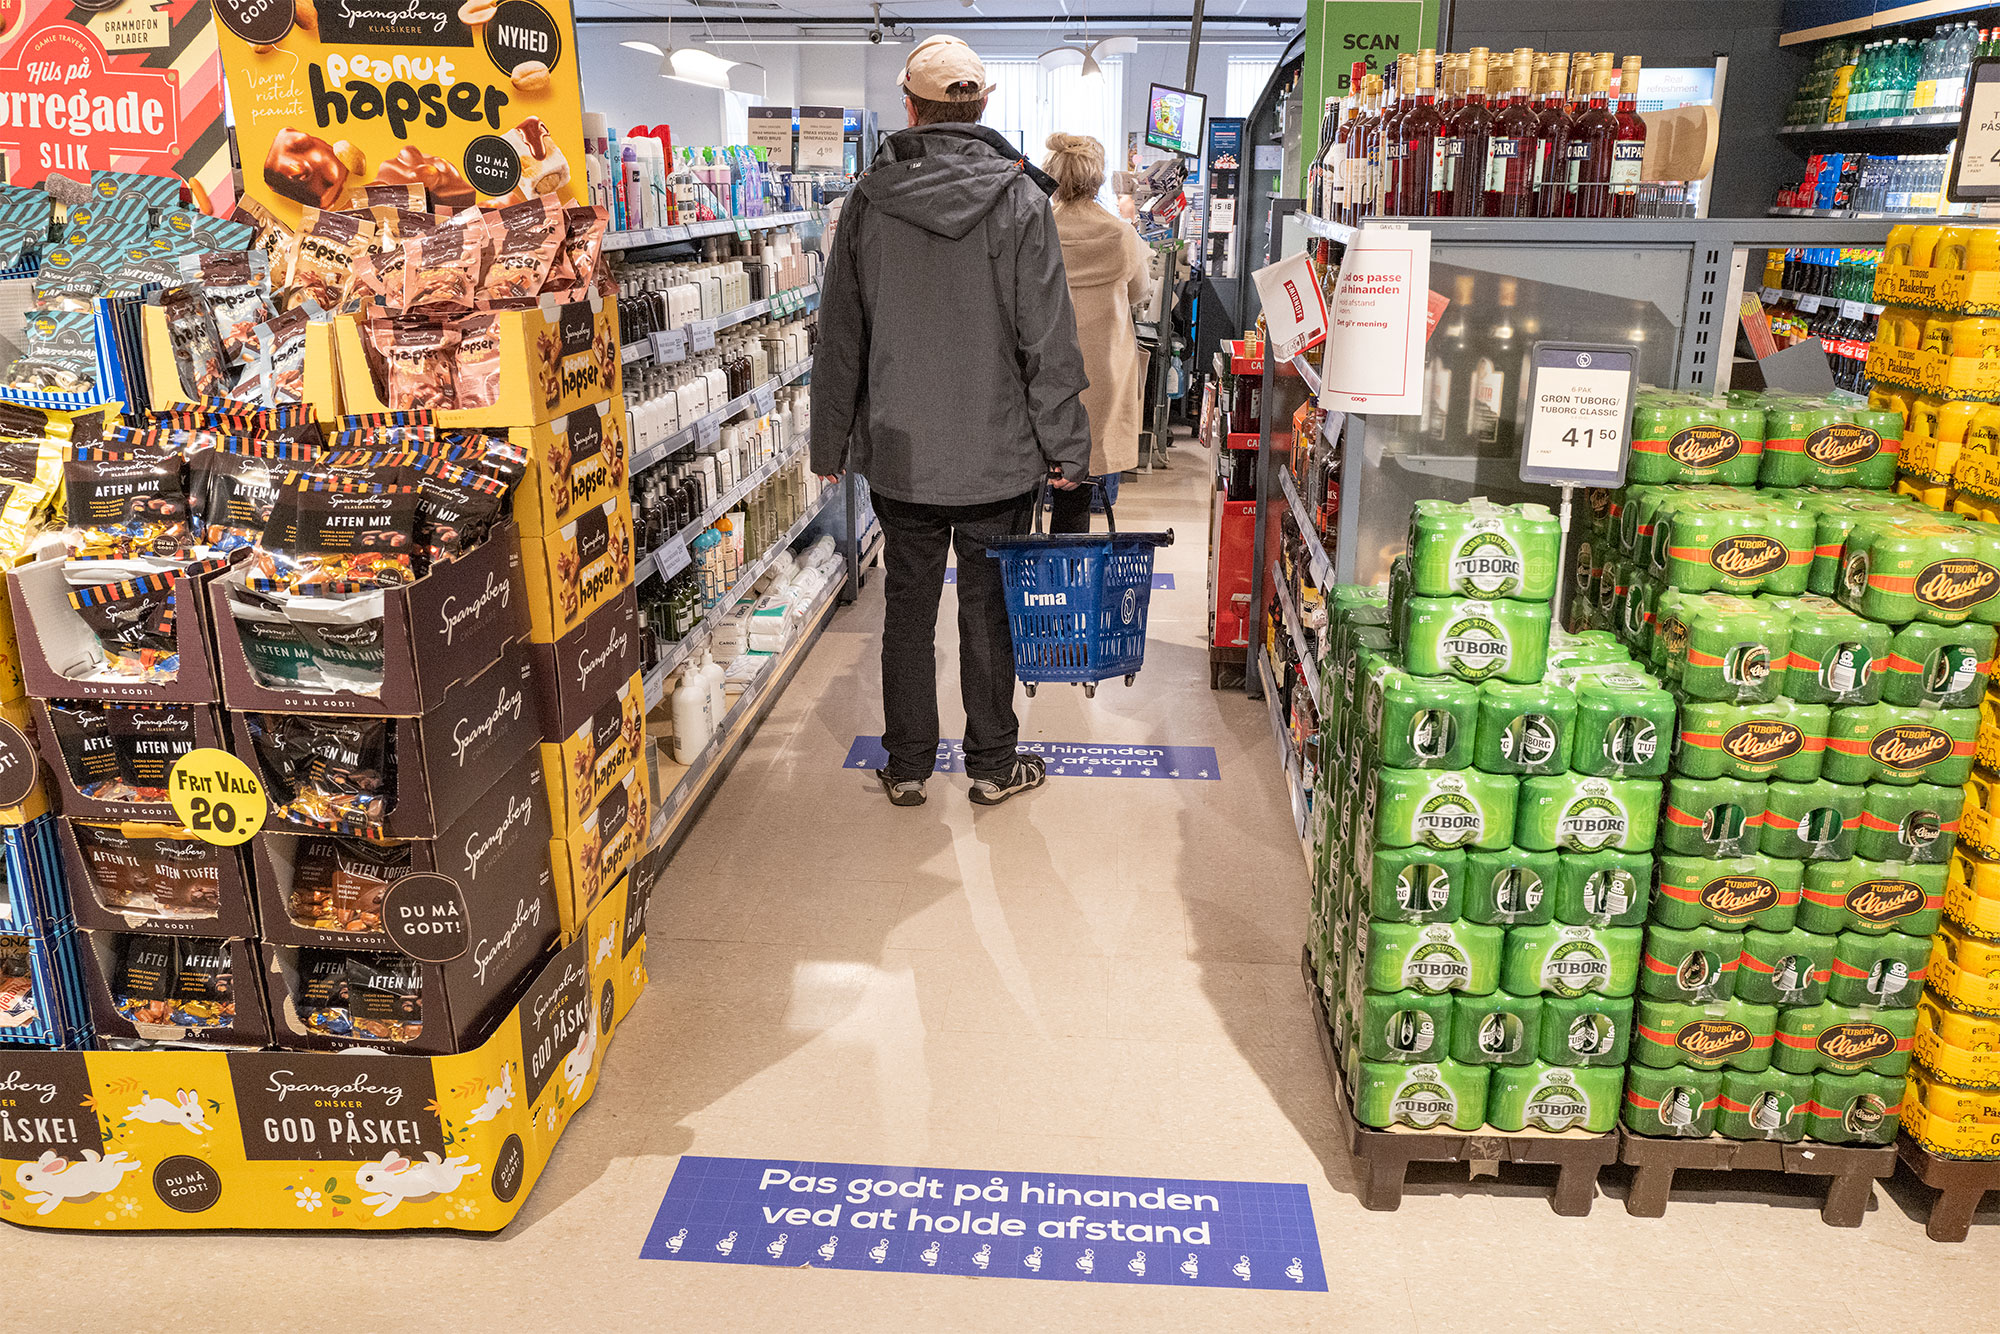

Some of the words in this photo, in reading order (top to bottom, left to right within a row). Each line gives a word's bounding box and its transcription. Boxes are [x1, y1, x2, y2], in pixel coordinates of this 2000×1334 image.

[338, 0, 449, 33] Spangsberg
[105, 19, 158, 32] GRAMMOFON
[368, 25, 422, 34] KLASSIKERE
[35, 35, 56, 51] GAMLE
[58, 35, 88, 53] TRAVERE
[116, 33, 148, 45] PLADER
[498, 24, 548, 53] NYHED
[1343, 34, 1400, 50] SCAN
[1364, 54, 1378, 70] &
[26, 62, 62, 85] Hils
[64, 56, 91, 84] på
[328, 53, 456, 88] peanut
[1664, 74, 1683, 84] Real
[256, 87, 303, 102] ristede
[1646, 84, 1698, 93] refreshment
[308, 62, 509, 139] hapser
[0, 89, 164, 136] ørregade
[251, 105, 308, 126] peanuts
[40, 142, 90, 170] SLIK
[475, 154, 491, 165] DU
[493, 156, 510, 169] MÅ
[475, 166, 509, 179] GODT!
[1353, 274, 1364, 282] os
[1367, 274, 1402, 284] passe
[1348, 285, 1400, 294] hinanden
[1898, 278, 1937, 298] Påskebryg
[1286, 282, 1303, 319] SMIRNOFF
[1981, 329, 1988, 337] 6
[1887, 359, 1921, 379] Påskebryg
[1978, 361, 1989, 370] 24
[561, 364, 599, 398] hapser
[1541, 395, 1570, 404] GRØN
[1575, 395, 1620, 406] TUBORG/
[1540, 406, 1577, 415] TUBORG
[1580, 408, 1618, 417] CLASSIC
[1562, 427, 1594, 448] 41
[1599, 429, 1617, 440] 50
[1690, 430, 1722, 439] TUBORG
[1828, 428, 1861, 438] TUBORG
[1676, 435, 1735, 463] Classic
[1812, 433, 1874, 460] Classic
[95, 485, 133, 497] AFTEN
[138, 480, 160, 492] MIX
[570, 466, 607, 505] hapser
[326, 516, 364, 527] AFTEN
[369, 516, 392, 526] MIX
[437, 507, 460, 522] MIX
[1733, 539, 1768, 550] TUBORG
[1455, 559, 1520, 575] TUBORG
[1717, 545, 1782, 573] Classic
[1940, 563, 1979, 575] TUBORG
[1921, 570, 1994, 603] Classic
[1024, 591, 1067, 606] Irma
[439, 570, 511, 645] Spangsberg
[1443, 640, 1508, 656] TUBORG
[103, 686, 116, 694] MÅ
[132, 713, 189, 731] Spangsberg
[452, 686, 523, 767] Spangsberg
[1747, 724, 1783, 735] TUBORG
[1895, 729, 1931, 739] TUBORG
[136, 742, 168, 754] AFTEN
[173, 742, 192, 754] MIX
[1052, 745, 1164, 757] hinanden
[1731, 731, 1797, 760] Classic
[1876, 736, 1946, 763] Classic
[1061, 755, 1158, 767] afstand
[176, 769, 213, 793] FRIT
[215, 771, 257, 794] VALG
[190, 797, 254, 835] 20.-
[1418, 815, 1480, 830] TUBORG
[1562, 819, 1625, 832] TUBORG
[465, 795, 532, 880] Spangsberg
[155, 841, 206, 859] Spangsberg
[1725, 880, 1759, 889] TUBORG
[1870, 884, 1905, 893] TUBORG
[1708, 886, 1773, 913] Classic
[1853, 889, 1918, 916] Classic
[400, 906, 424, 918] DU
[432, 901, 460, 917] MÅ
[403, 921, 462, 935] GODT!
[473, 897, 541, 986] Spangsberg
[185, 955, 219, 968] AFTEN
[1547, 962, 1608, 975] TUBORG
[1407, 964, 1468, 978] TUBORG
[1988, 982, 1999, 990] 24
[532, 963, 587, 1032] Spangsberg
[549, 994, 569, 1020] ØNSKER
[1699, 1024, 1733, 1033] TUBORG
[1841, 1027, 1876, 1036] TUBORG
[1684, 1030, 1746, 1057] Classic
[1825, 1033, 1888, 1060] Classic
[532, 1043, 552, 1078] GOD
[1972, 1055, 1982, 1063] 24
[266, 1070, 404, 1106] Spangsberg
[314, 1100, 363, 1108] ØNSKER
[1395, 1100, 1454, 1113] TUBORG
[1527, 1103, 1587, 1116] TUBORG
[2, 1110, 79, 1144] ÅSKE!
[264, 1118, 316, 1143] GOD
[329, 1112, 421, 1145] PÅSKE!
[166, 1177, 183, 1187] DU
[186, 1171, 205, 1184] MÅ
[170, 1182, 208, 1198] GODT!
[758, 1169, 839, 1194] Pas
[846, 1174, 946, 1204] godt
[953, 1177, 1009, 1210] på
[1020, 1180, 1220, 1213] hinanden
[761, 1203, 843, 1228] ved
[850, 1205, 897, 1231] at
[907, 1207, 1027, 1238] holde
[1037, 1215, 1212, 1245] afstand
